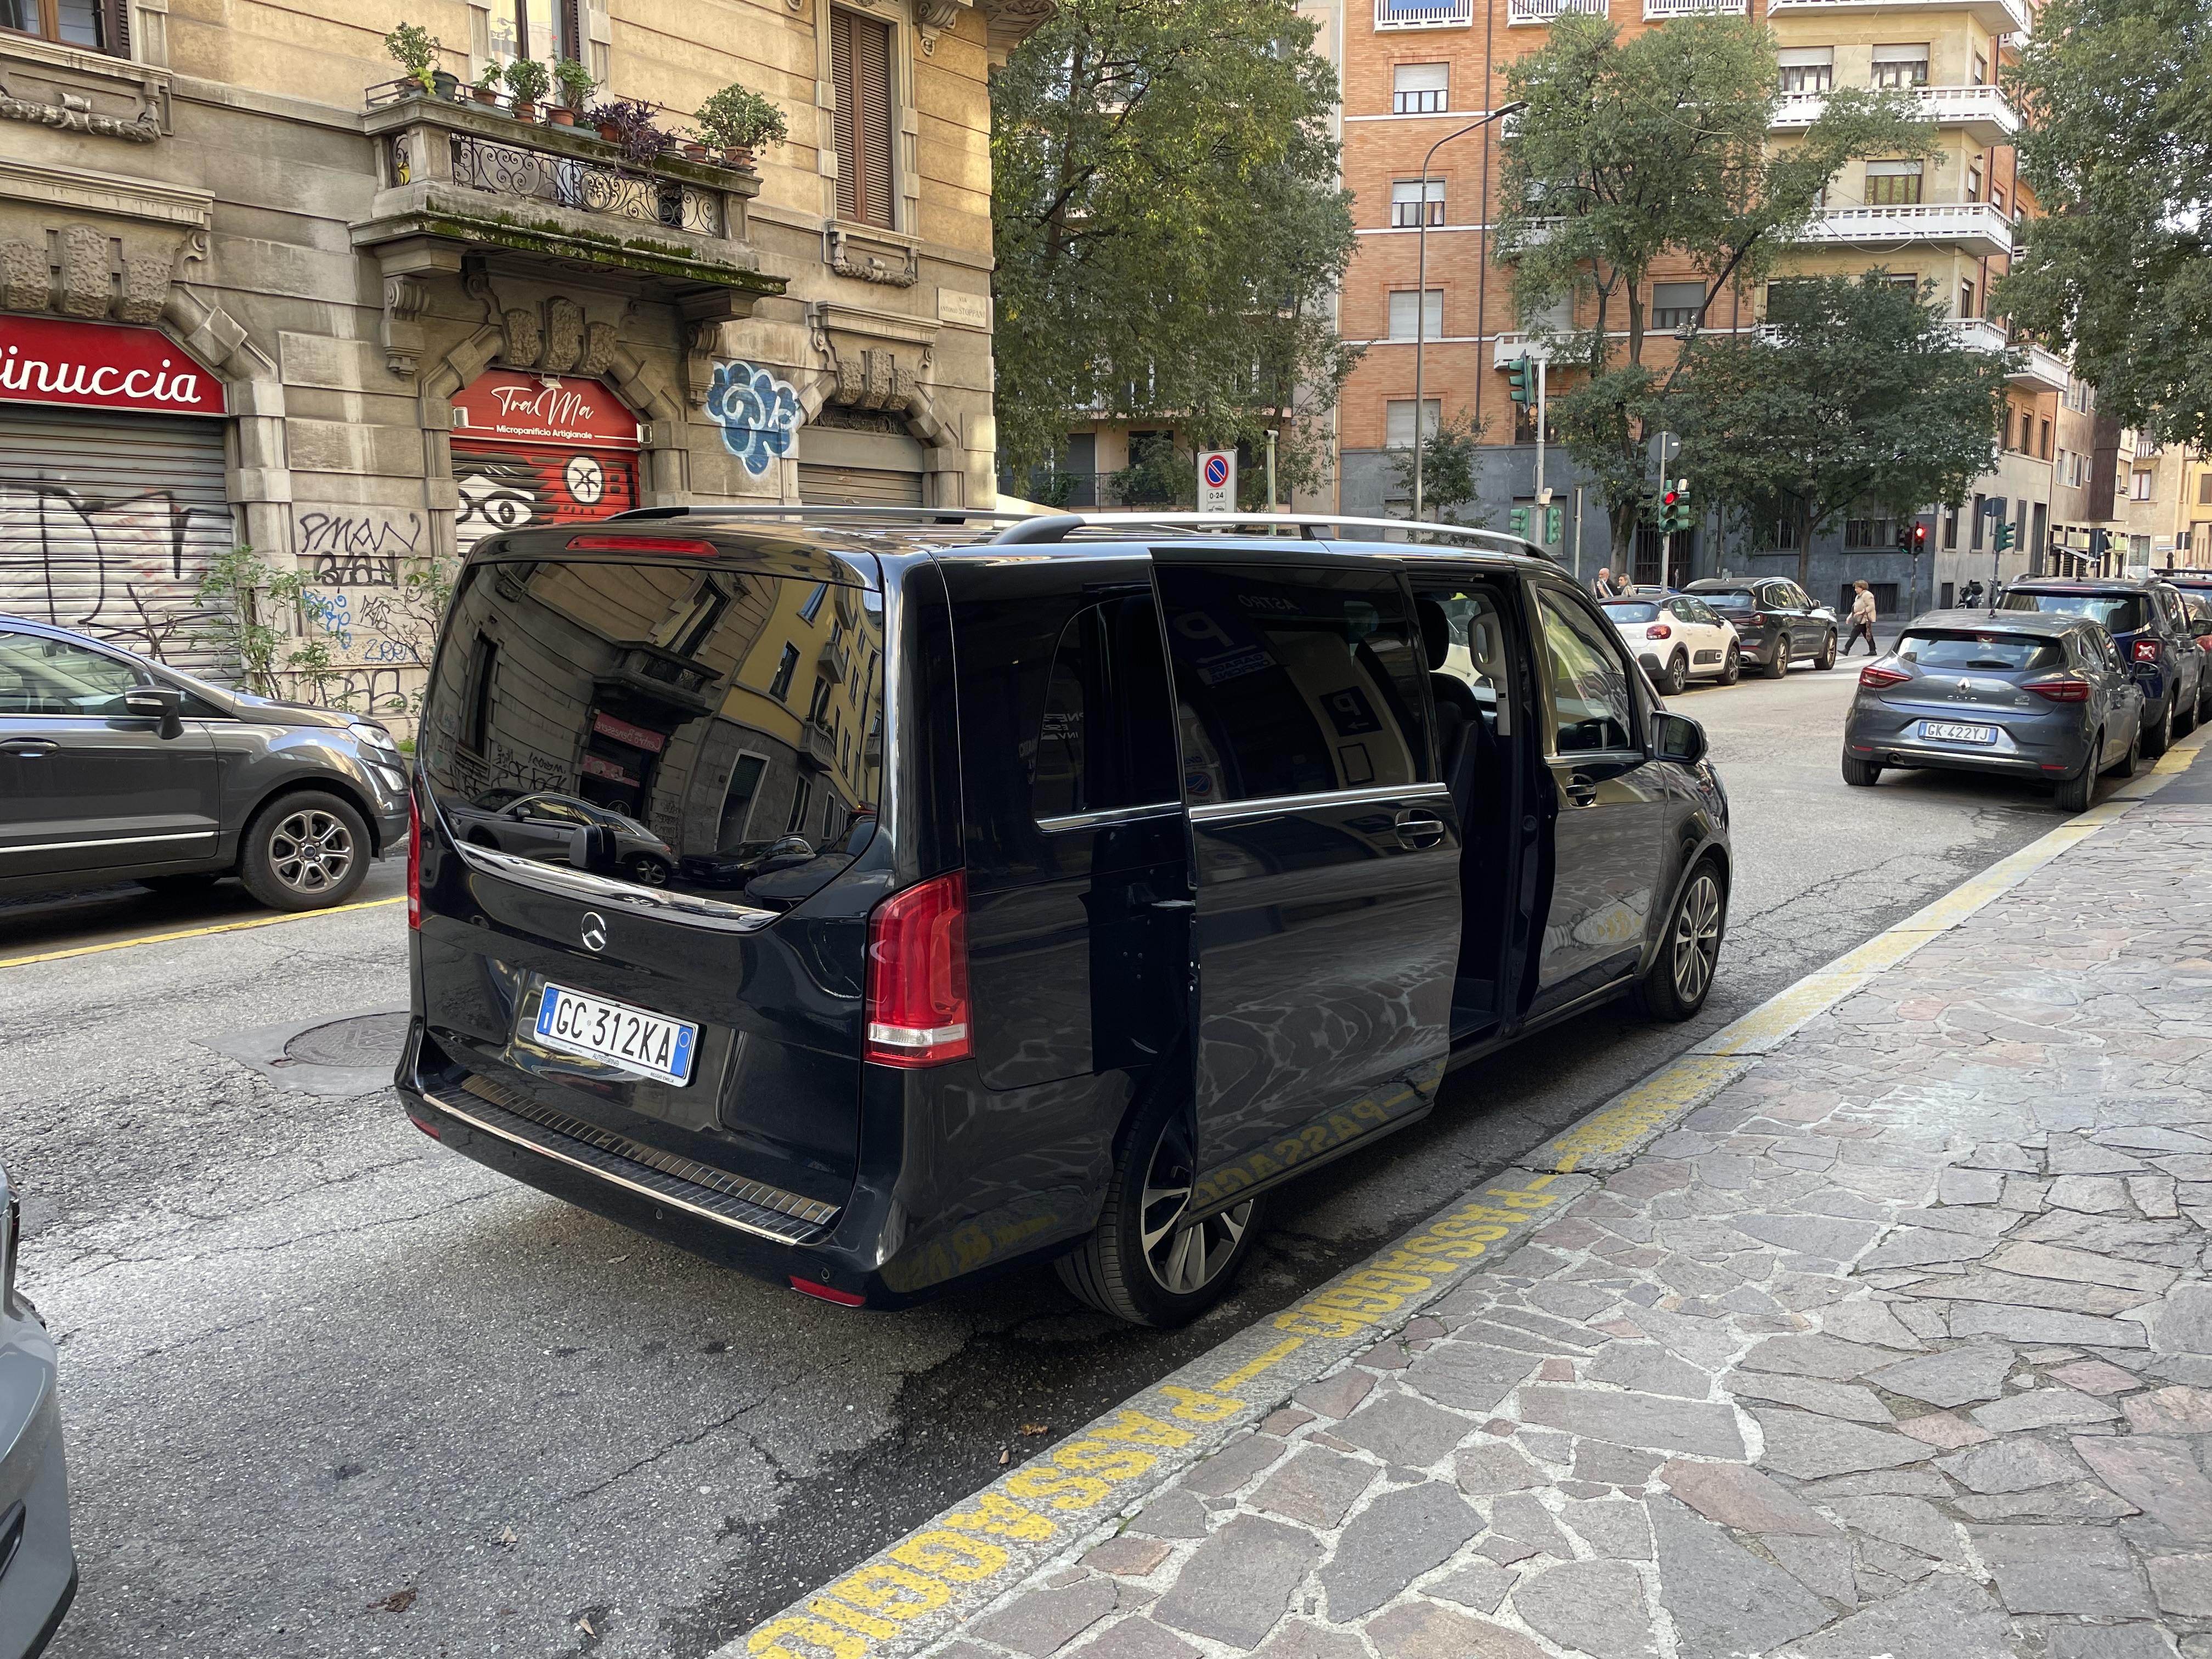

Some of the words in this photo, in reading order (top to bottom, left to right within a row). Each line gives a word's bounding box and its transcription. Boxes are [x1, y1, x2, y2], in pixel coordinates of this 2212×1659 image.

[940, 306, 958, 314] ANTONIO
[958, 307, 985, 318] STOPPANI
[0, 345, 201, 403] inuccia
[496, 425, 551, 436] Micropanificio
[552, 429, 592, 439] Artigianale
[1928, 724, 1944, 736] GK
[1948, 726, 1989, 741] 422YJ
[556, 998, 587, 1039] GC
[592, 1008, 671, 1068] 312KA
